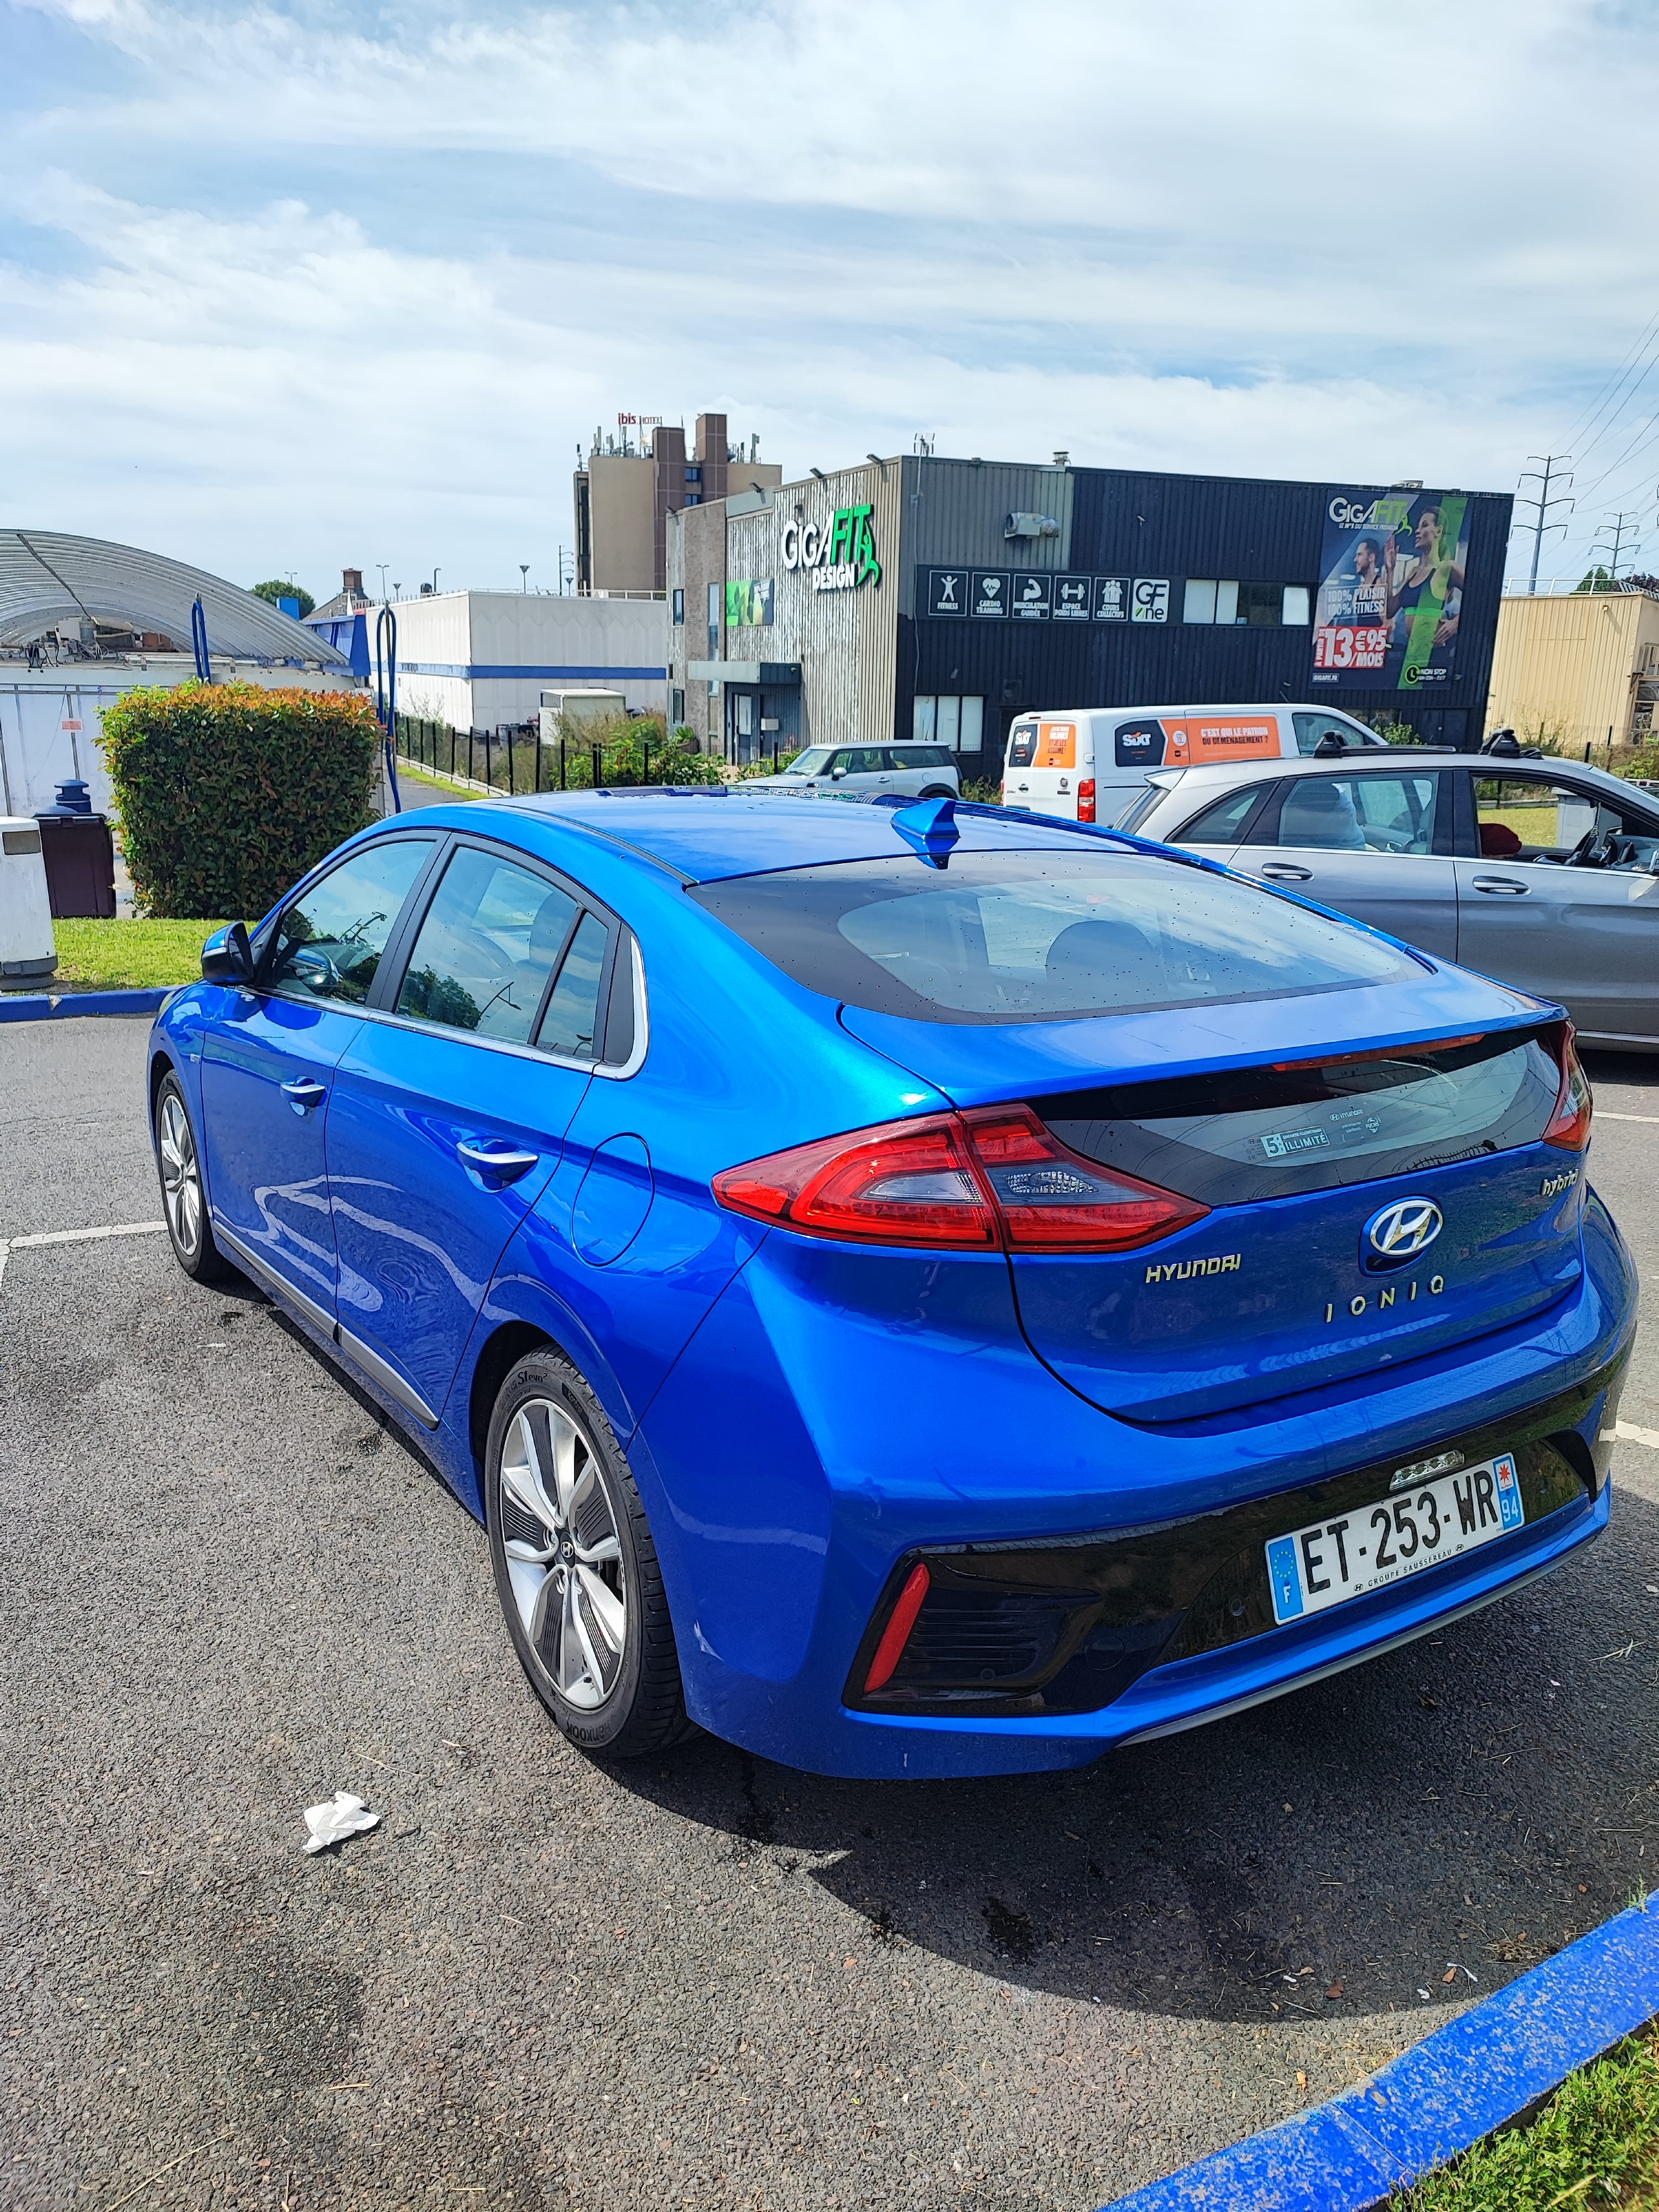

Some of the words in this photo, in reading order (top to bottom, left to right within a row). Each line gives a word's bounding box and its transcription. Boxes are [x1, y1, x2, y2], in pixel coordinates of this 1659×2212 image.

[618, 413, 636, 424] ibis
[1329, 497, 1407, 524] GIGAFIT
[782, 504, 872, 569] GIGAFIT
[812, 564, 855, 589] DESIGN
[1136, 581, 1167, 607] GF
[1328, 589, 1352, 602] 100%
[1354, 587, 1386, 602] PLAISIR
[937, 602, 958, 610] FITNESS
[1328, 603, 1352, 615] 100%
[1353, 600, 1385, 614] FITNESS
[1123, 732, 1151, 747] SIXT
[1201, 727, 1220, 737] C'EST
[1220, 727, 1233, 737] QUI
[1233, 727, 1242, 736] LE
[1243, 726, 1269, 736] PATRON
[1339, 1109, 1364, 1118] HYUNDAI
[1266, 1138, 1279, 1154] 5
[1284, 1132, 1327, 1151] ILLIMITÉ
[1542, 1168, 1579, 1197] hybrid
[1145, 1253, 1241, 1284] HYUNDAI
[1326, 1275, 1444, 1323] IONIQ
[1501, 1495, 1519, 1522] 94
[1368, 1569, 1400, 1587] GROUPE
[1404, 1548, 1452, 1573] SAUSSEREAU
[1283, 1585, 1291, 1604] F
